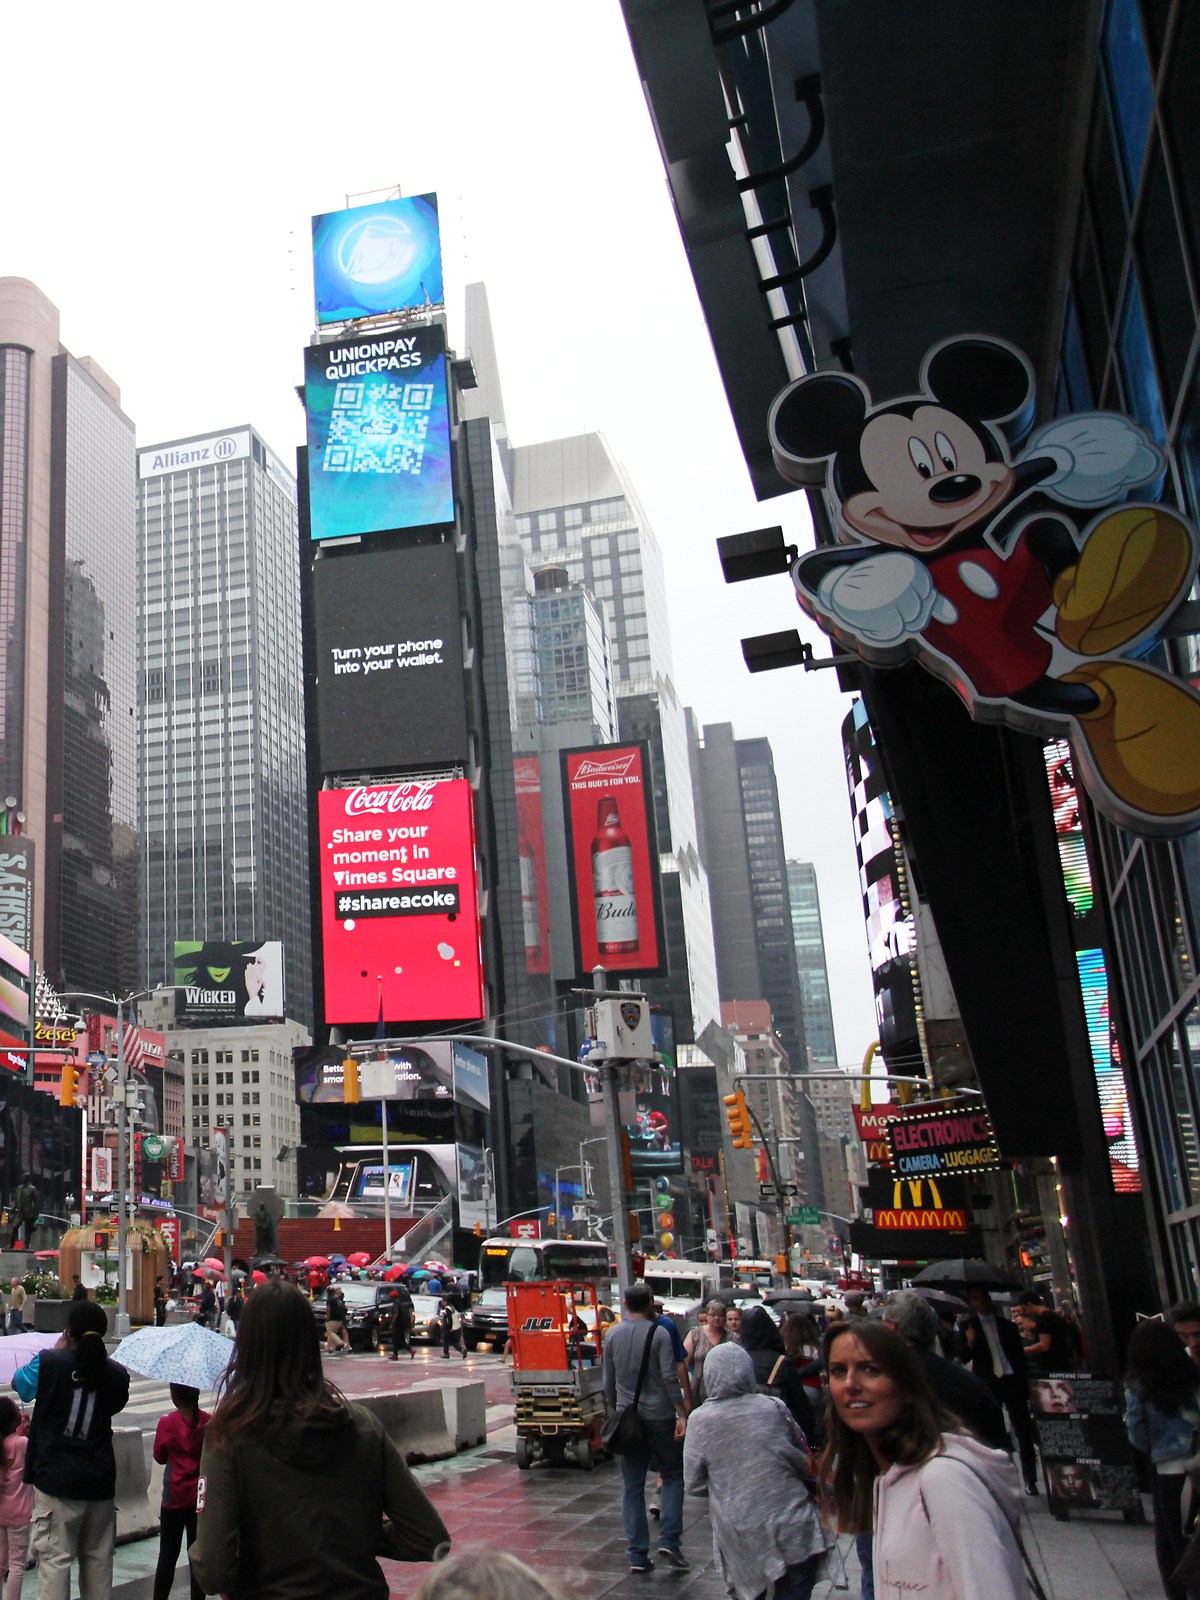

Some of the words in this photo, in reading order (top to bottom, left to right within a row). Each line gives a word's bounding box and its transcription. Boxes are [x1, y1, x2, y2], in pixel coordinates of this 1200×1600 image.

[329, 337, 417, 364] UNIONPAY
[326, 352, 422, 380] QUICKPASS
[152, 448, 210, 471] Allianz
[332, 648, 361, 661] Turn
[363, 643, 395, 661] your
[397, 638, 443, 656] phone
[334, 661, 360, 675] into
[363, 658, 394, 675] your
[397, 652, 444, 668] wallet.
[579, 761, 630, 776] Budweiser
[571, 781, 587, 790] THIS
[588, 779, 609, 789] BUD'S
[610, 777, 624, 787] FOR
[625, 776, 641, 785] YOU.
[345, 782, 437, 816] Coca-Cola
[332, 828, 383, 844] Share
[387, 825, 429, 842] your
[333, 847, 408, 864] moment
[412, 845, 430, 860] in
[334, 871, 388, 886] Times
[392, 866, 457, 884] Square
[338, 890, 456, 912] #shareacoke
[893, 1116, 990, 1150] ELECTRONICS
[899, 1154, 940, 1173] CAMERA
[944, 1147, 995, 1168] LUGGAGE
[522, 1317, 553, 1330] JLG
